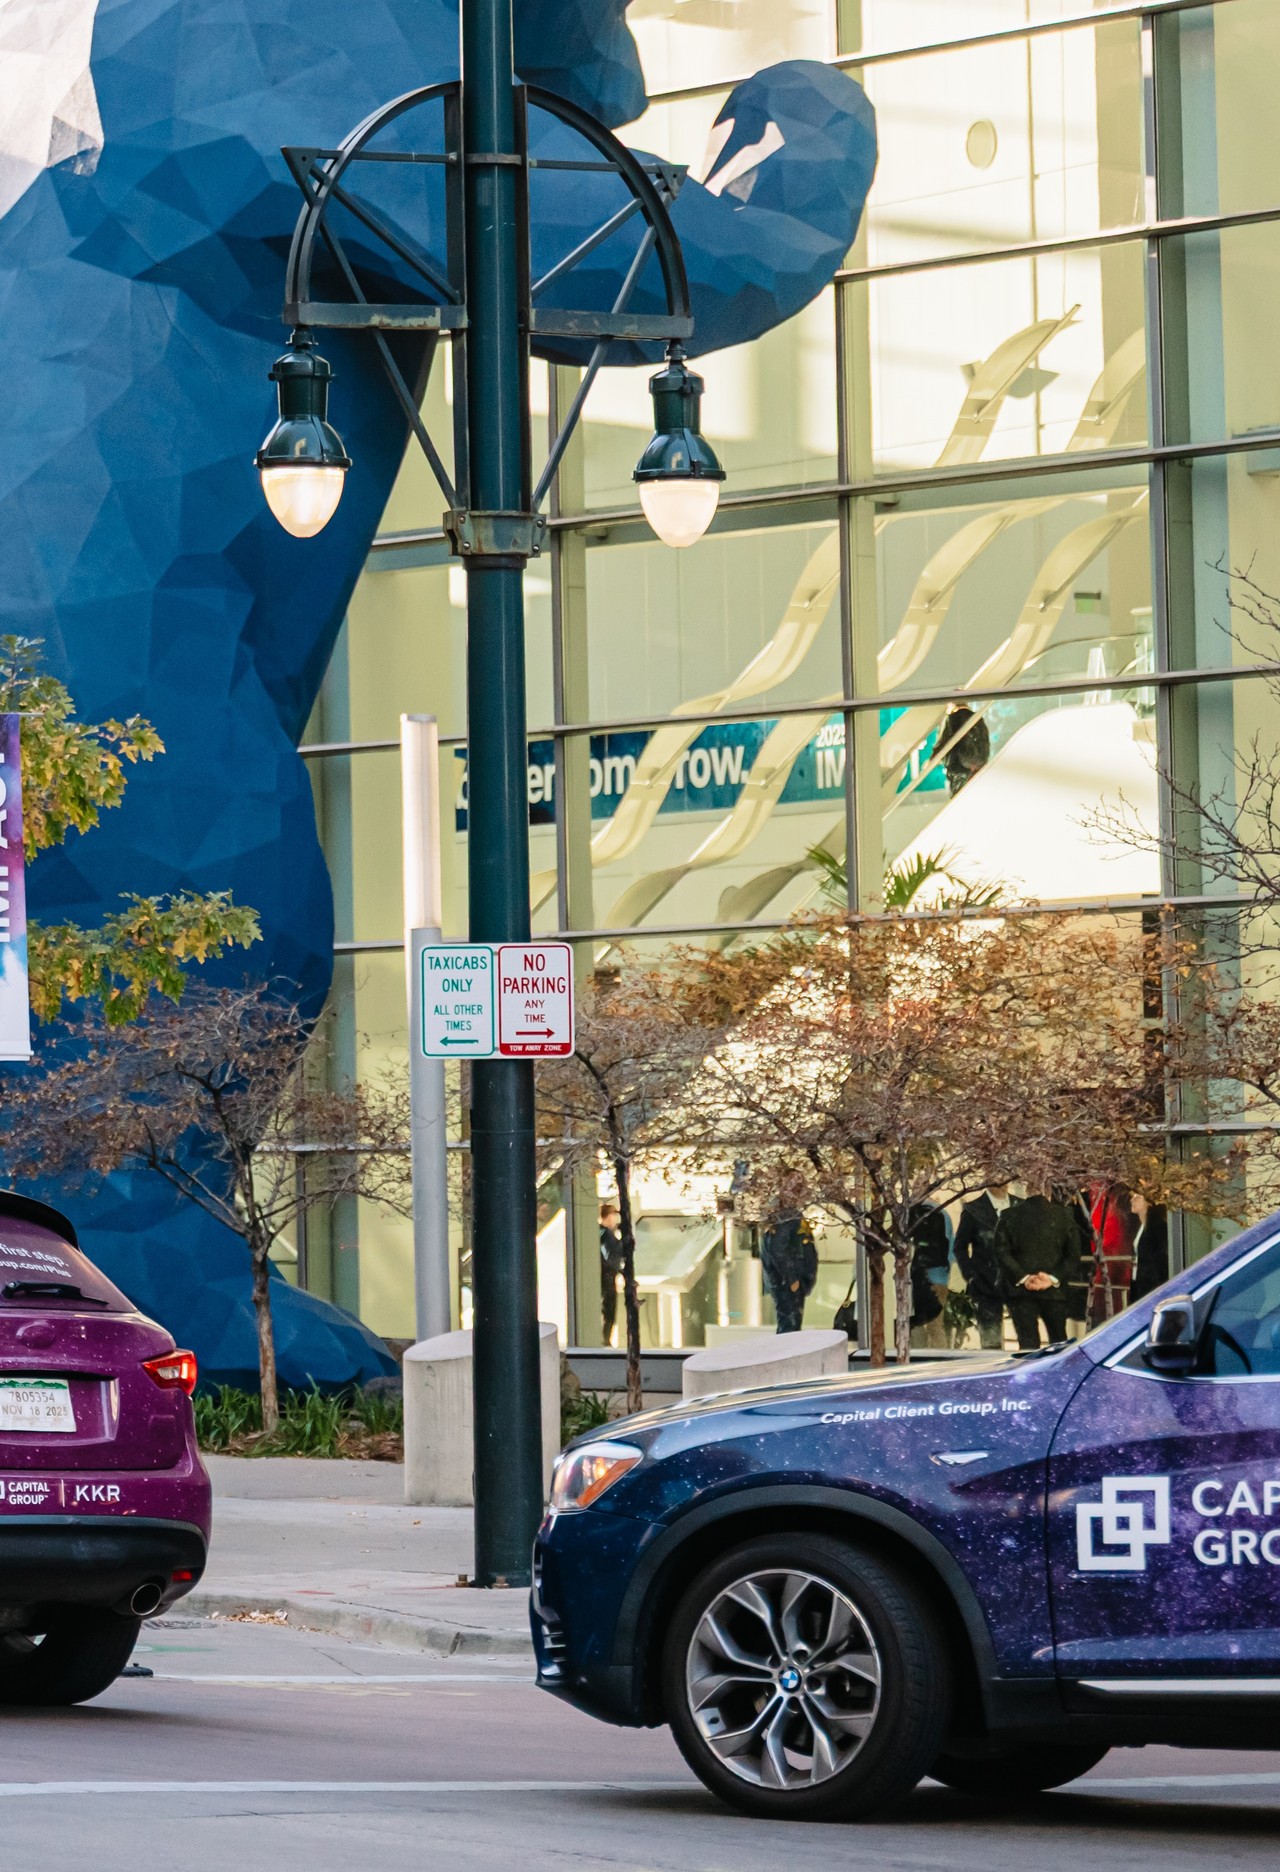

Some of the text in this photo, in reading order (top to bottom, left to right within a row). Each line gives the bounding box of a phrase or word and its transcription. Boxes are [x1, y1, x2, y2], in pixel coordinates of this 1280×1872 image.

[428, 956, 488, 970] TAXICABS
[523, 953, 546, 972] NO
[442, 978, 473, 993] ONLY
[503, 977, 566, 994] PARKING
[433, 1004, 483, 1015] ALL OTHER
[524, 999, 546, 1009] ANY
[524, 1013, 546, 1023] TIME
[446, 1020, 472, 1032] TIMES
[544, 1044, 563, 1052] ZONE
[32, 1251, 70, 1268] step.
[1, 1405, 68, 1417] NOV 18 2025
[820, 1399, 1032, 1425] Capital Client Group, Inc.
[8, 1481, 51, 1493] CAPITAL
[75, 1484, 121, 1502] KKR
